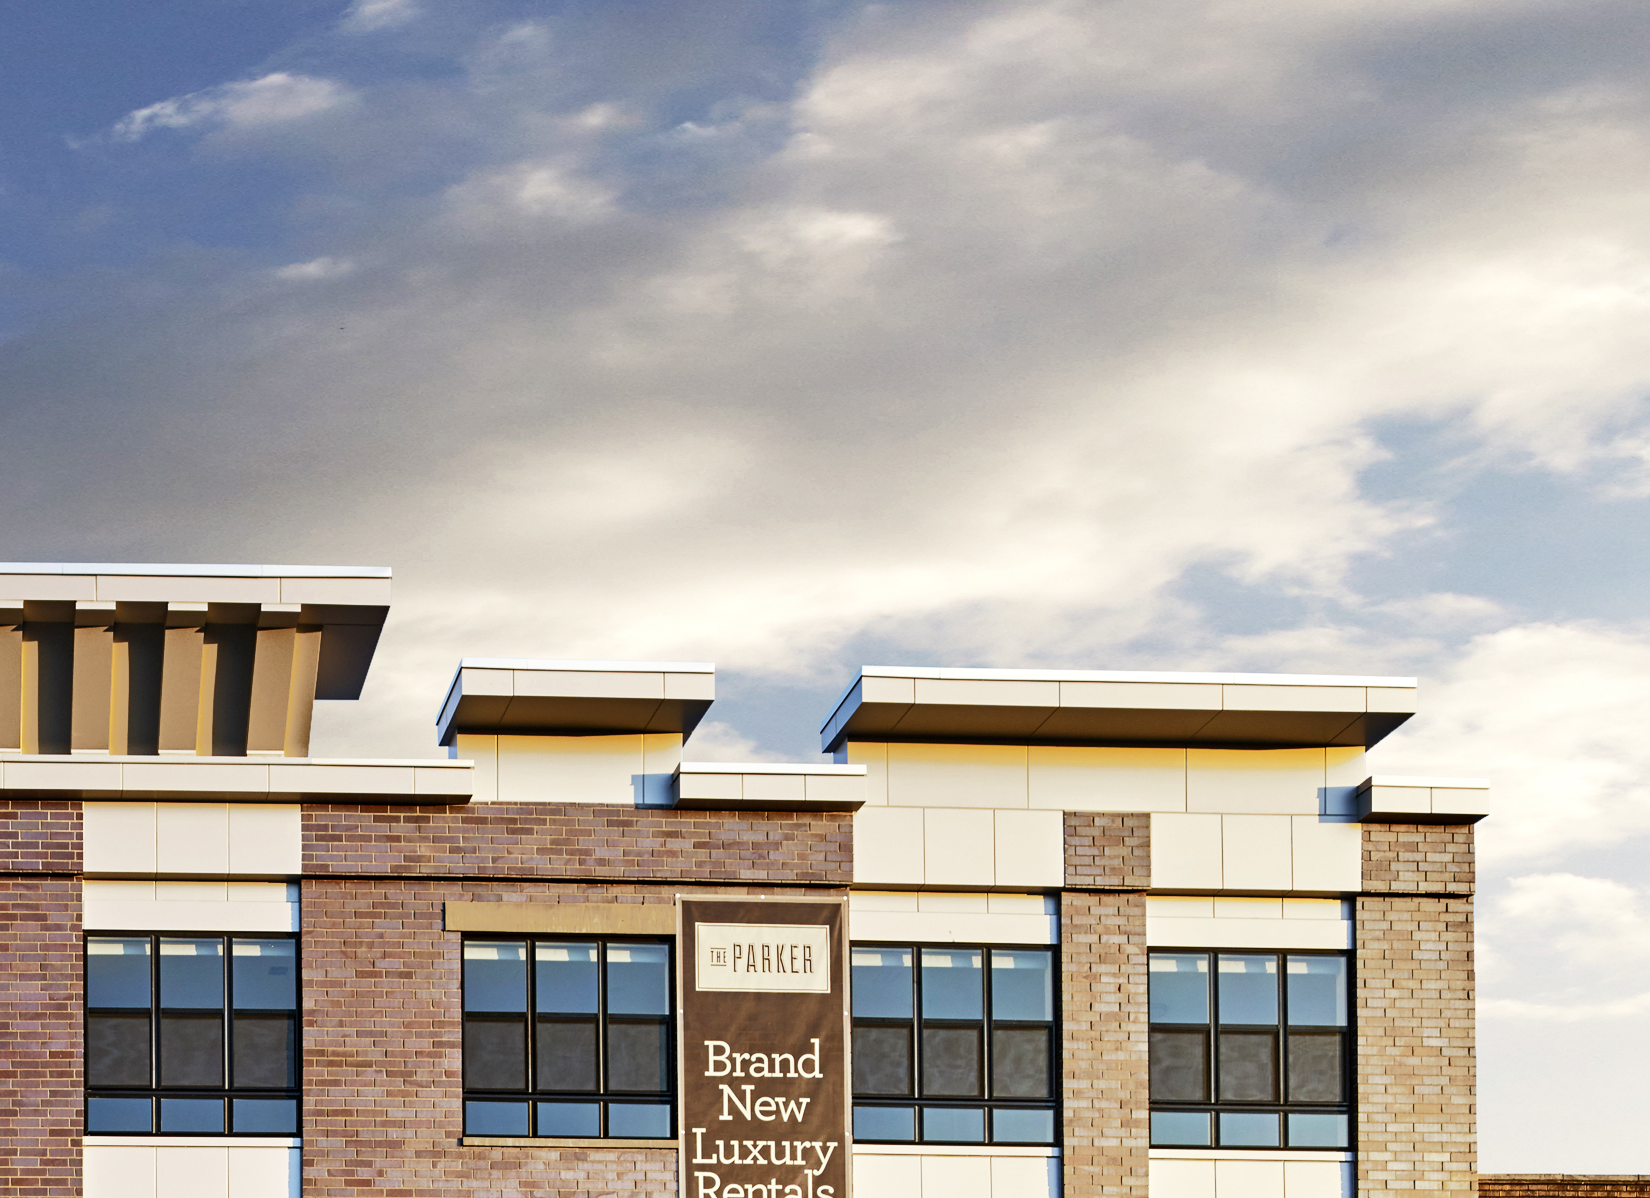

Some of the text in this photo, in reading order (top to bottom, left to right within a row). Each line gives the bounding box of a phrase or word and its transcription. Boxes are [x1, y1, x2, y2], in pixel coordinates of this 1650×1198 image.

[710, 942, 814, 974] THE PARKER
[704, 1038, 823, 1079] Brand
[718, 1084, 810, 1122] New
[691, 1127, 838, 1176] Luxury
